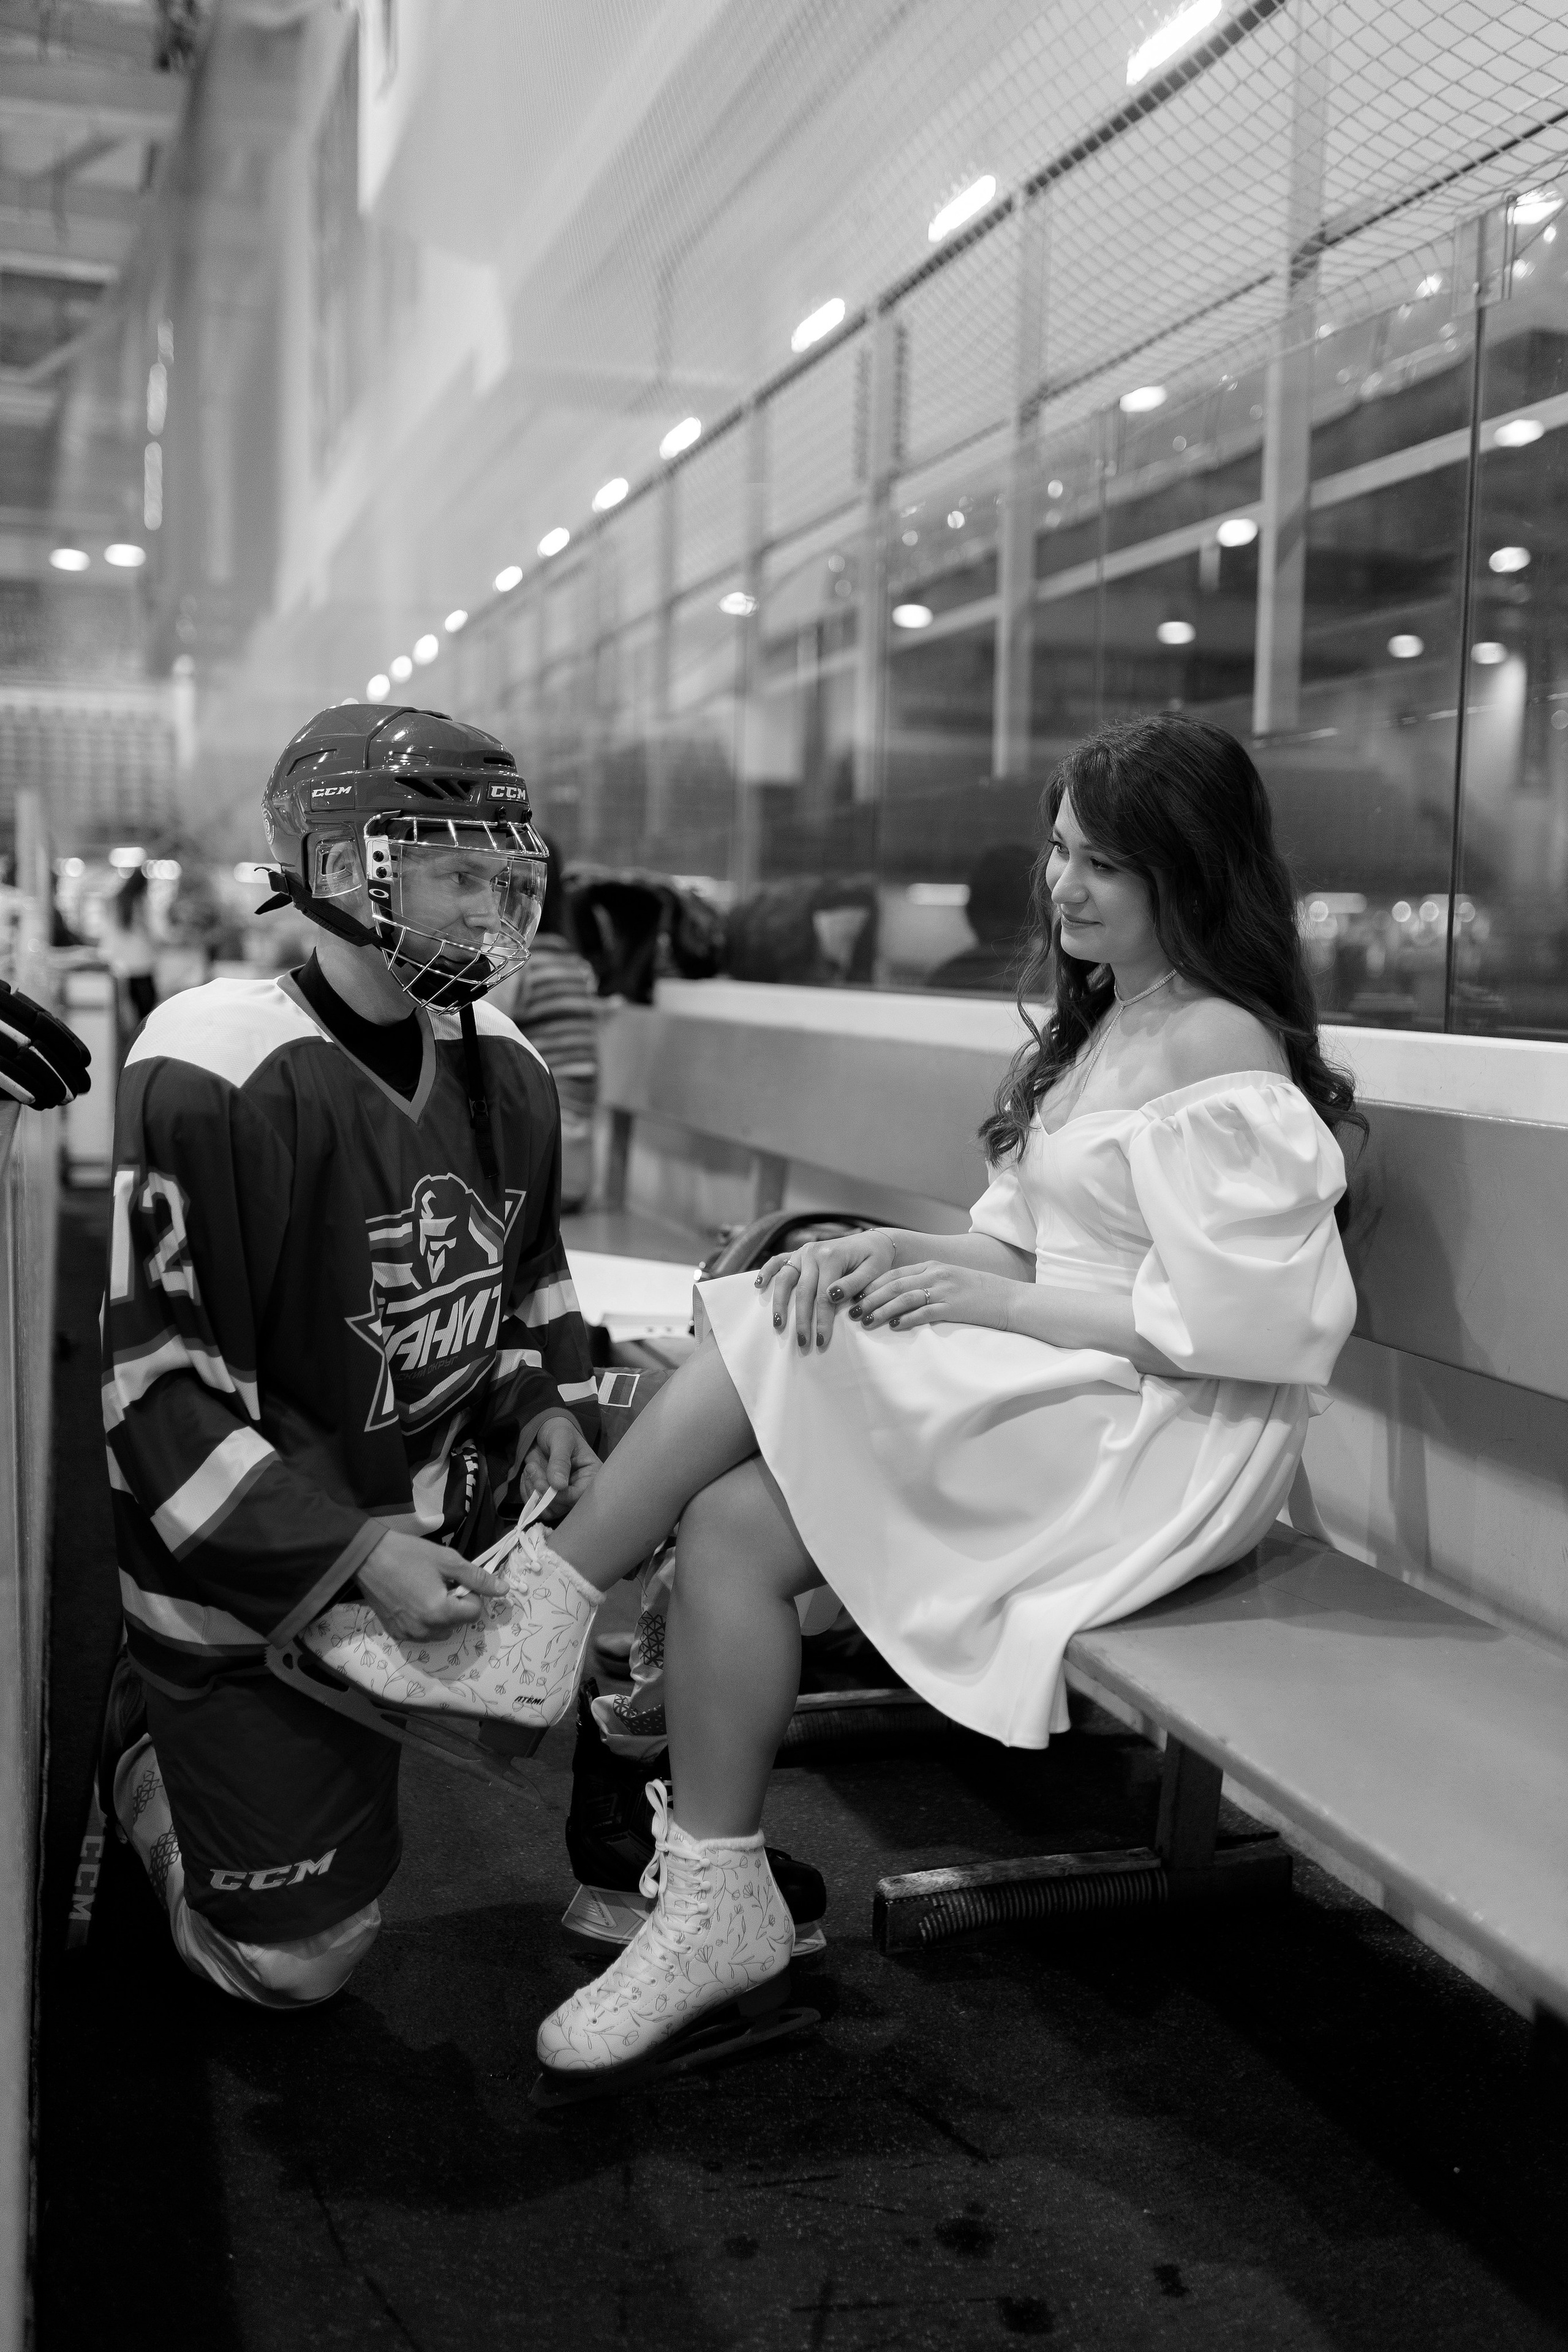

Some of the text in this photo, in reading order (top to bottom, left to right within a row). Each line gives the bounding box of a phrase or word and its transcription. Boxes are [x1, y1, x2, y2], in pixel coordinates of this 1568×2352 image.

[312, 786, 353, 798] CCM
[491, 786, 526, 801] CCM
[110, 1167, 197, 1303] 12
[383, 1283, 502, 1371] АНИТ
[428, 1355, 458, 1374] ОКРУГ
[68, 1836, 105, 1921] CCM
[209, 1848, 337, 1891] CCM
